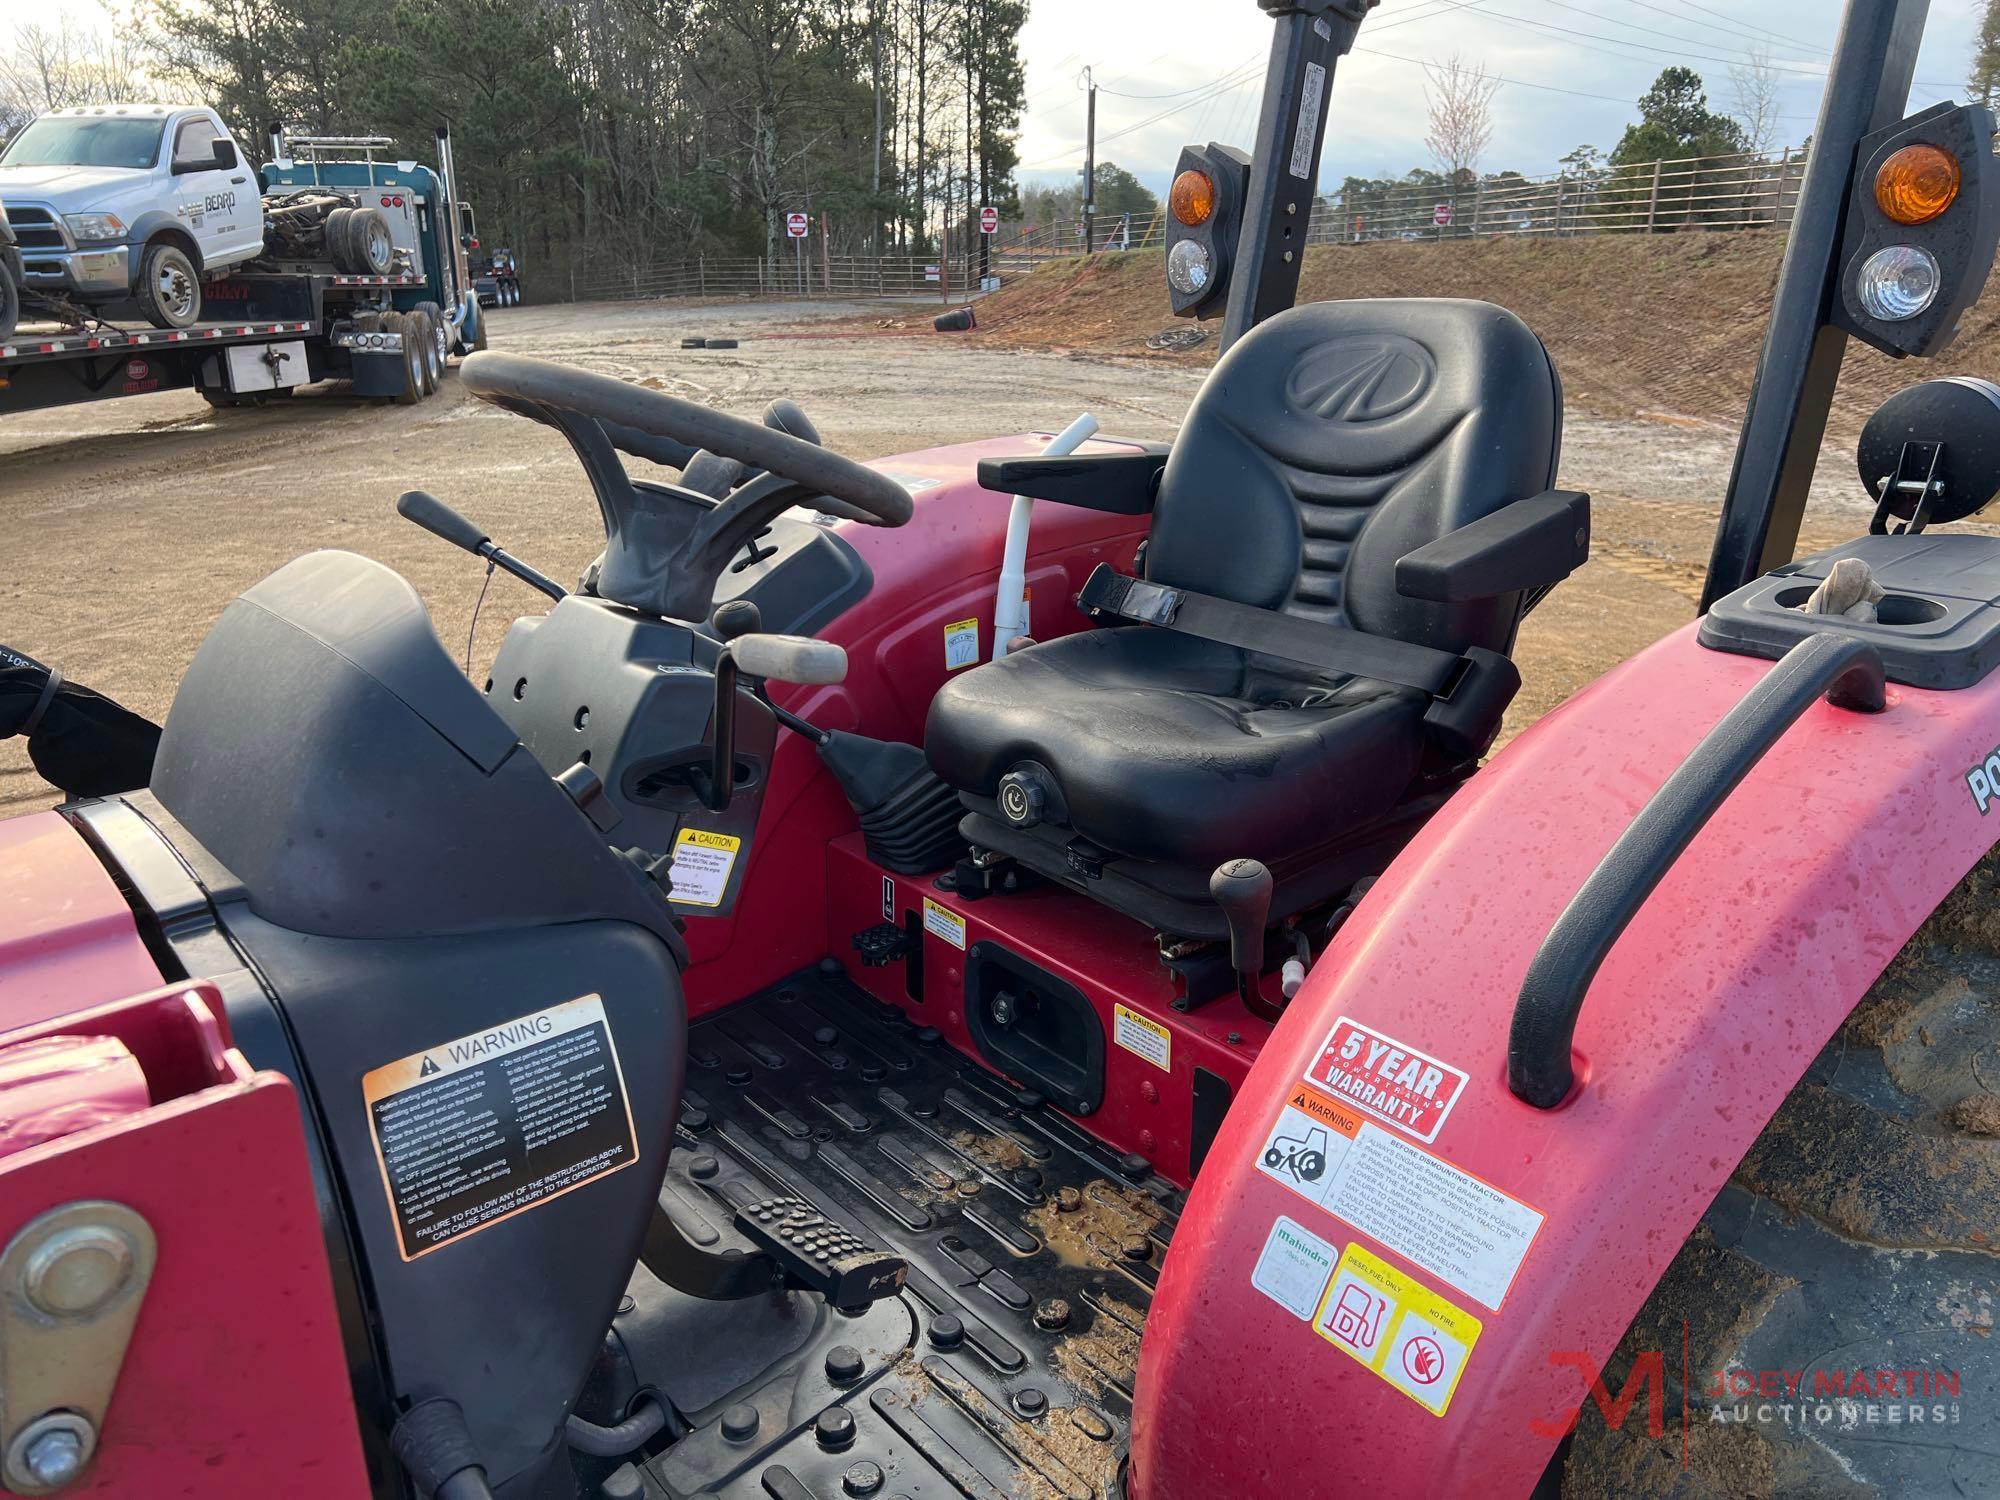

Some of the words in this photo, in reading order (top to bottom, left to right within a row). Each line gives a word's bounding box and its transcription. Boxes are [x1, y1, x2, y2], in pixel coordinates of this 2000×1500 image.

[205, 191, 235, 215] BEARD
[697, 833, 733, 847] CAUTION
[936, 906, 957, 922] CAUTION
[448, 1014, 552, 1065] WARNING
[1134, 1014, 1160, 1034] CAUTION
[1332, 1056, 1430, 1108] POWERTRAIN
[1337, 1029, 1367, 1062] 5
[1357, 1039, 1446, 1100] YEAR
[1306, 1099, 1354, 1131] WARNING
[1323, 1065, 1424, 1127] WARRANTY
[1356, 1159, 1384, 1179] ACROSS
[1384, 1175, 1399, 1187] THE
[1363, 1144, 1383, 1159] PARK
[1382, 1154, 1394, 1165] ON
[1393, 1161, 1416, 1177] LEVEL
[1415, 1173, 1447, 1194] GROUND
[1447, 1190, 1489, 1218] WHENEVER
[1367, 1137, 1395, 1156] ALWAYS
[1394, 1152, 1424, 1172] ENGAGE
[1424, 1168, 1456, 1190] PARKING
[1367, 1156, 1397, 1176] PARKING
[1397, 1172, 1409, 1183] ON
[1440, 1196, 1475, 1220] POSITION
[1390, 1139, 1418, 1158] BEFORE
[1418, 1154, 1468, 1185] DISMOUNTING
[1468, 1181, 1505, 1205] TRACTOR
[416, 1217, 451, 1238] FAILURE
[452, 1212, 463, 1223] TO
[464, 1197, 498, 1218] FOLLOW
[499, 1190, 514, 1202] ANY
[515, 1185, 527, 1195] OF
[528, 1177, 543, 1190] THE
[544, 1154, 598, 1183] INSTRUCTIONS
[597, 1144, 622, 1160] ABOVE
[432, 1227, 451, 1242] CAN
[450, 1215, 479, 1233] CAUSE
[479, 1199, 515, 1221] SERIOUS
[515, 1187, 543, 1205] INJURY
[544, 1182, 555, 1193] TO
[555, 1175, 570, 1188] THE
[1340, 1189, 1364, 1207] COULD
[1364, 1203, 1388, 1221] CAUSE
[1387, 1217, 1413, 1235] INJURY
[1413, 1232, 1425, 1242] OR
[1348, 1174, 1377, 1194] FAILURE
[1376, 1190, 1386, 1200] TO
[1386, 1196, 1415, 1216] COMPLY
[1415, 1213, 1426, 1223] TO
[1426, 1219, 1443, 1233] THIS
[1352, 1166, 1377, 1185] LOWER
[1376, 1180, 1390, 1192] ALL
[1389, 1188, 1434, 1217] IMPLEMENTS
[1434, 1213, 1445, 1224] TO
[1445, 1220, 1461, 1233] THE
[1333, 1204, 1365, 1227] POSITION
[1364, 1222, 1380, 1236] AND
[1379, 1232, 1399, 1247] STOP
[1398, 1243, 1414, 1257] THE
[1336, 1196, 1359, 1213] PLACE
[1371, 1217, 1403, 1240] SHUTTLE
[1402, 1236, 1425, 1253] LEVER
[1426, 1250, 1435, 1259] IN
[1435, 1255, 1469, 1279] NEUTRAL
[1344, 1181, 1359, 1194] MAY
[1358, 1190, 1382, 1207] ALLOW
[1383, 1204, 1397, 1216] THE
[1397, 1212, 1427, 1234] WHEELS
[1428, 1230, 1438, 1240] TO
[1438, 1236, 1455, 1250] SLIP
[1454, 1246, 1472, 1260] AND
[1347, 1255, 1369, 1273] DIESEL
[1368, 1268, 1385, 1283] FUEL
[1384, 1278, 1401, 1294] ONLY
[1428, 1307, 1439, 1318] NO
[1439, 1314, 1455, 1328] FIRE
